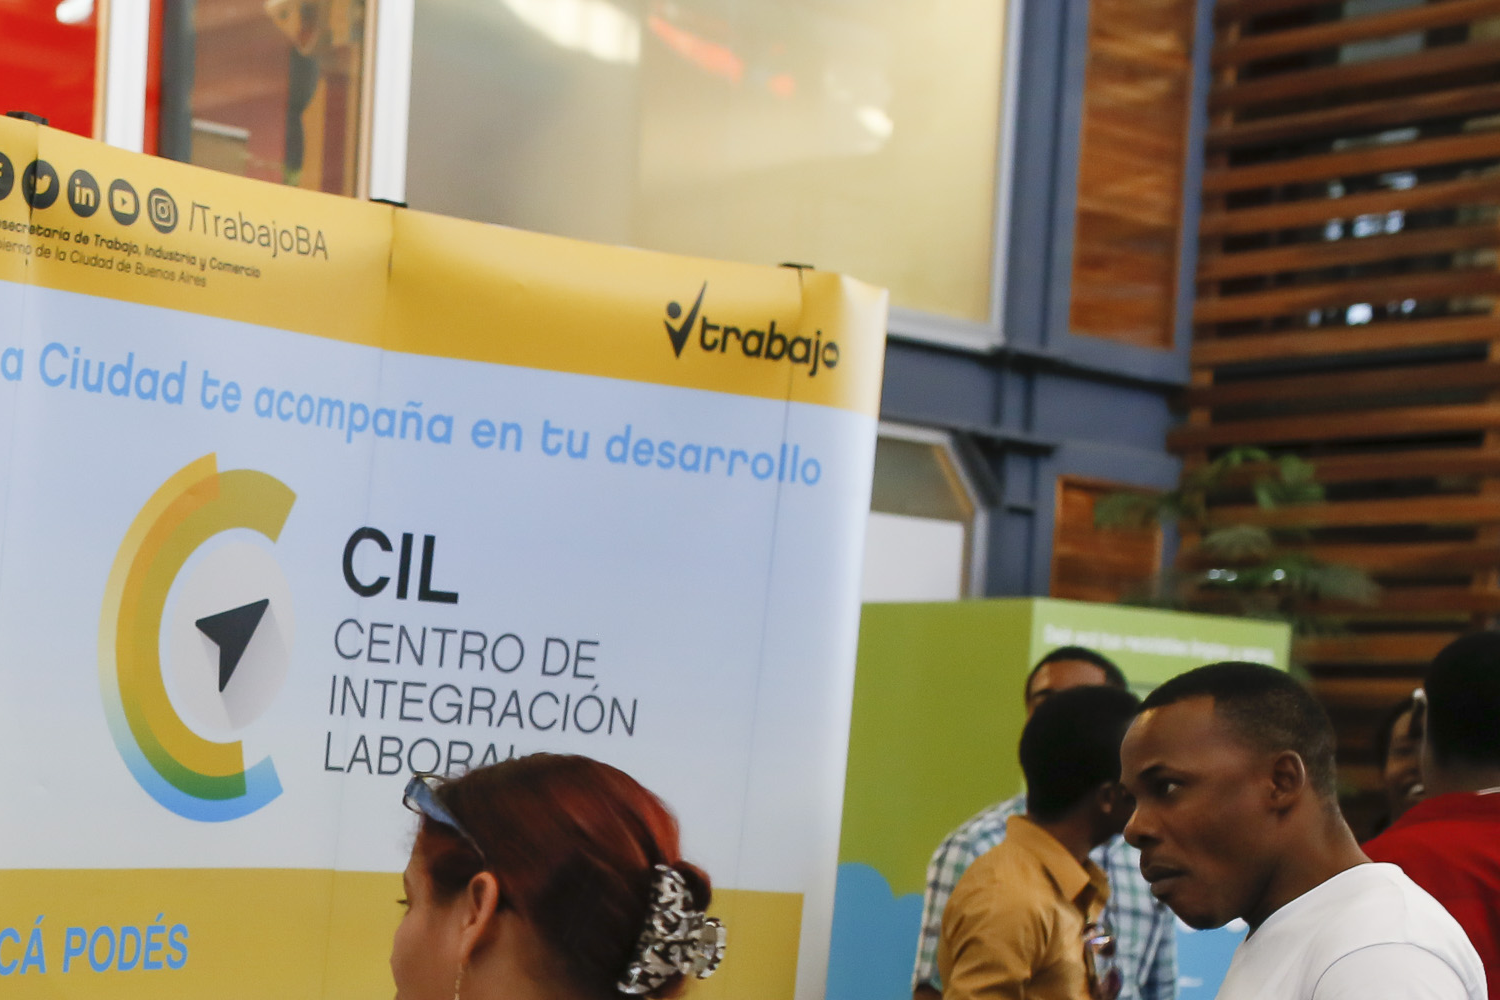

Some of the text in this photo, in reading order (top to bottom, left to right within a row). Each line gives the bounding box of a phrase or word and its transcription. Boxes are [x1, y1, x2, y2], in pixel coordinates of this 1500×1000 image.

[74, 230, 90, 245] de
[94, 233, 142, 257] Trabajo,
[144, 244, 197, 266] Industria
[200, 258, 207, 272] y
[209, 256, 262, 279] Comercio
[188, 201, 330, 261] /TrabajoBA
[35, 243, 52, 259] de
[55, 247, 67, 261] la
[69, 249, 114, 271] Ciudad
[116, 259, 132, 273] de
[135, 261, 176, 282] Buenos
[178, 271, 207, 288] Aires
[700, 315, 840, 378] trabajo
[39, 341, 188, 406] Ciudad
[200, 369, 242, 414] te
[253, 386, 453, 445] acompaña
[471, 416, 523, 452] en
[540, 418, 590, 460] tu
[605, 424, 822, 487] desarrollo
[342, 526, 459, 605] CIL
[333, 618, 600, 680] CENTRO DE
[328, 674, 638, 737] INTEGRACIÓN
[62, 912, 190, 973] PODÉS
